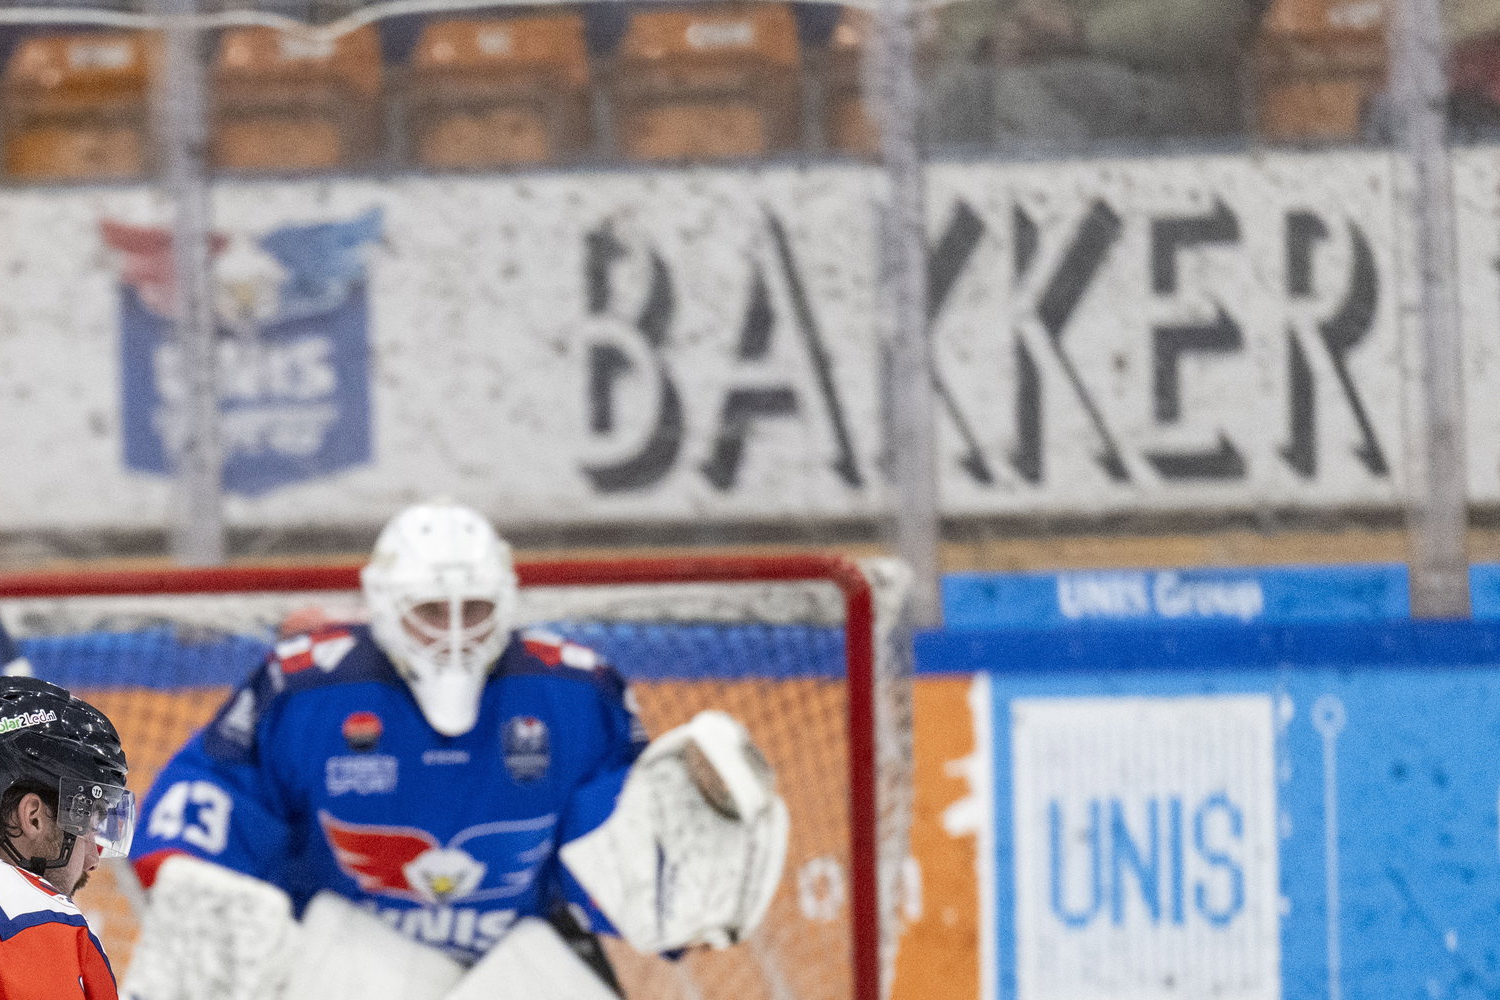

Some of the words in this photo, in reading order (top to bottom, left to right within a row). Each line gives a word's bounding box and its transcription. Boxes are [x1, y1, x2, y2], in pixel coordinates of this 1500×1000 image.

[582, 196, 1390, 492] BAKKER
[1056, 572, 1148, 618] UNIS
[1154, 569, 1263, 622] Group
[147, 780, 234, 855] 43
[1048, 791, 1245, 928] UNIS
